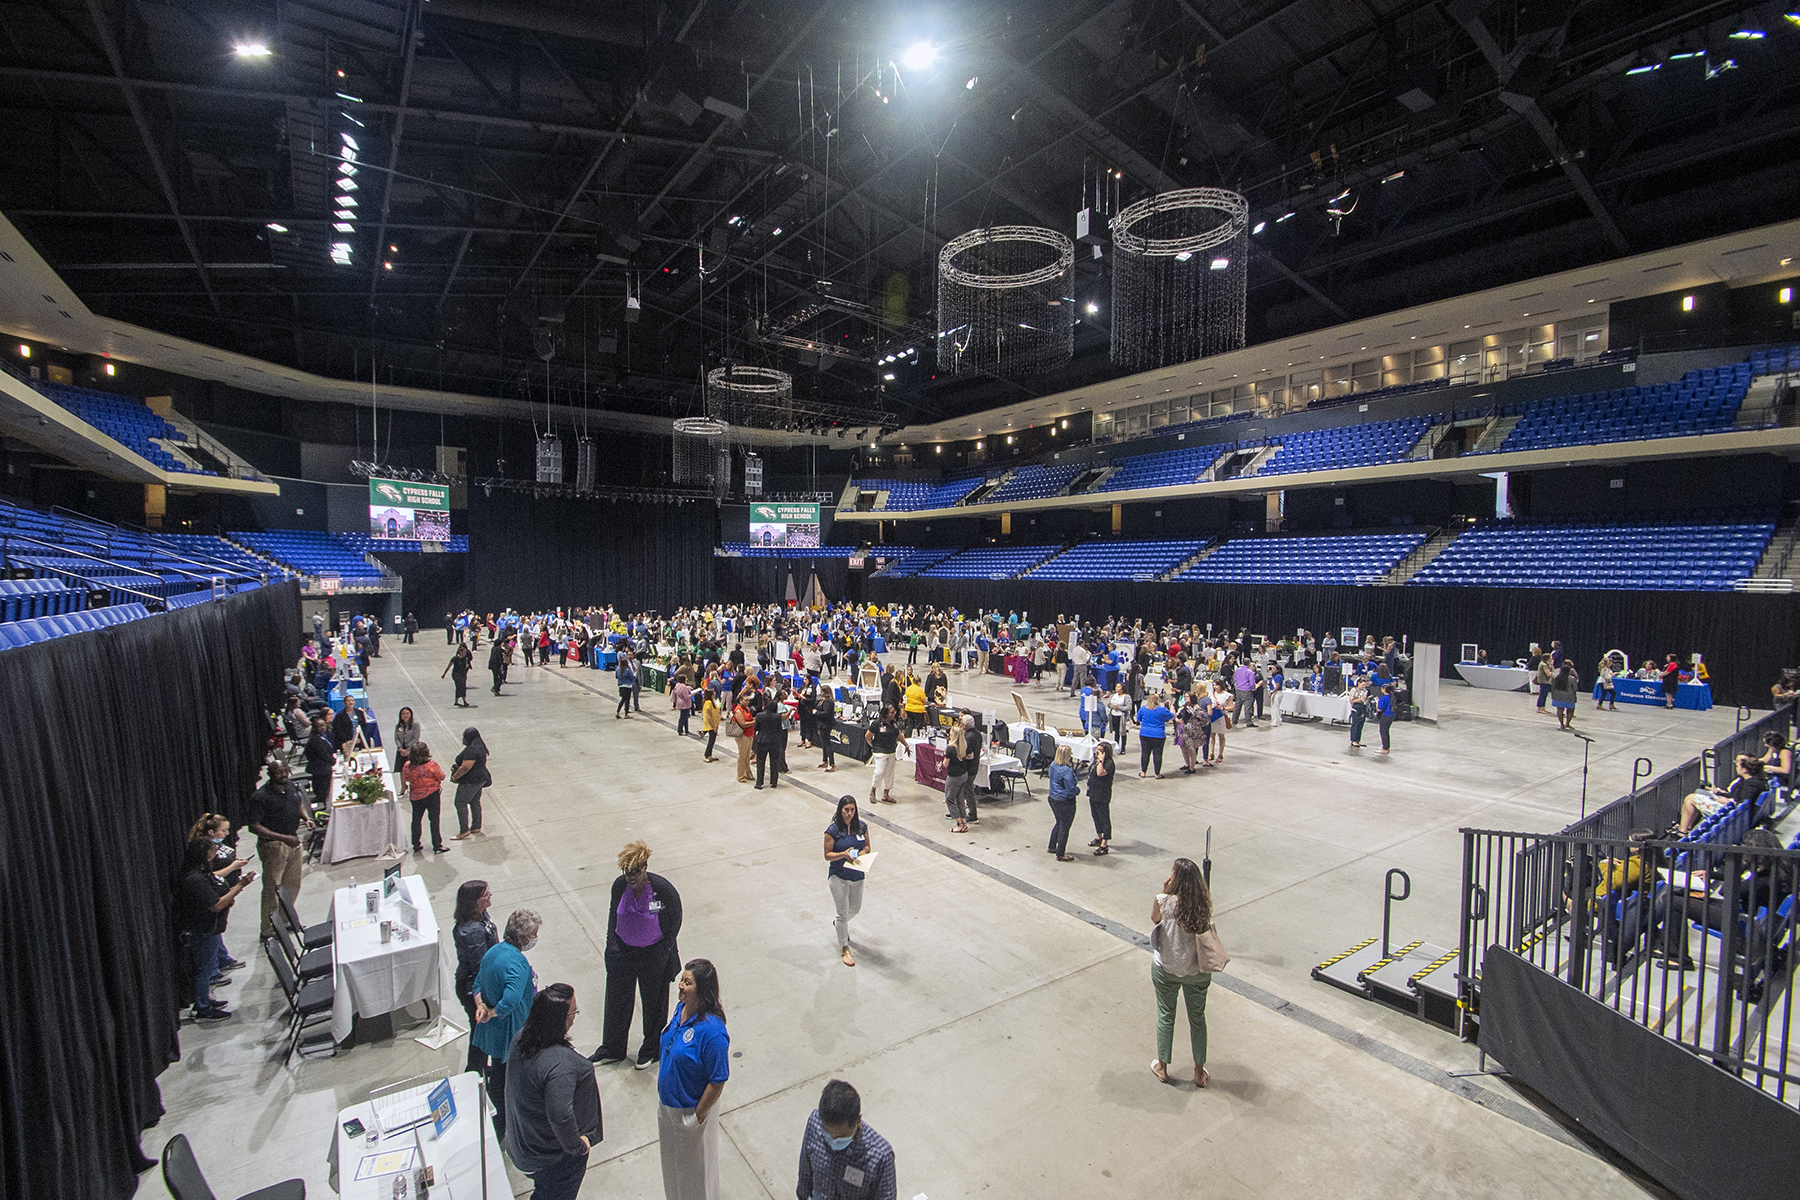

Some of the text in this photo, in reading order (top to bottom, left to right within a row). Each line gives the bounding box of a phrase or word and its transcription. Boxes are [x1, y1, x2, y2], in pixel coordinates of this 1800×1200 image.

[402, 487, 445, 498] CYPRESS FALLS
[421, 497, 442, 505] SCHOOL
[321, 580, 339, 590] EXIT
